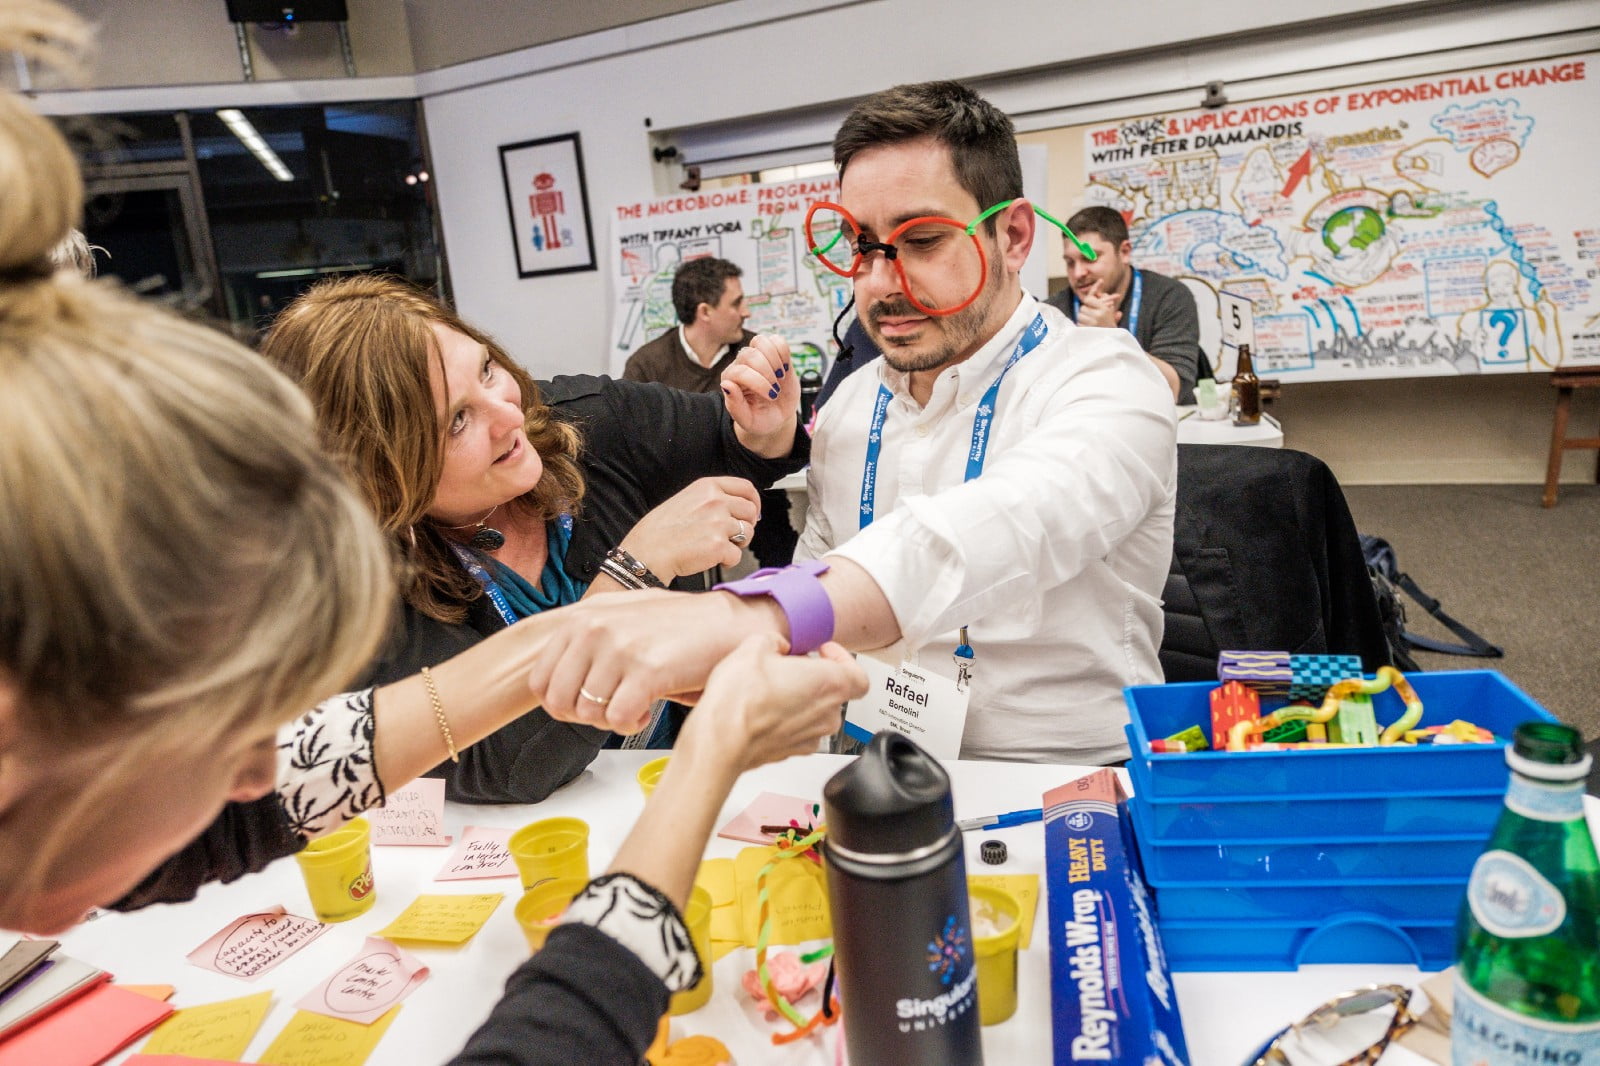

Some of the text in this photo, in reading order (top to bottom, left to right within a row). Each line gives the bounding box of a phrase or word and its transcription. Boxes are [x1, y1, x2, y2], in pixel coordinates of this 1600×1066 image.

[1091, 129, 1118, 147] THE
[1167, 119, 1180, 136] &
[1183, 106, 1309, 134] IMPLICATIONS
[1313, 96, 1342, 115] OF
[1347, 76, 1491, 112] EXPONENTIAL
[1495, 61, 1587, 90] CHANGE
[1092, 147, 1134, 164] WITH
[1140, 138, 1189, 157] PETER
[1195, 121, 1303, 150] DIAMANDIS
[617, 203, 643, 221] THE
[619, 220, 743, 246] WITH TIFFANY VORA
[1231, 303, 1242, 330] 5
[973, 419, 989, 462] Singularity
[885, 677, 929, 708] Rafael
[888, 699, 920, 719] Bortolini
[1068, 838, 1091, 884] HEAVY
[1090, 839, 1107, 872] DUTY
[1070, 944, 1117, 1061] Reynolds
